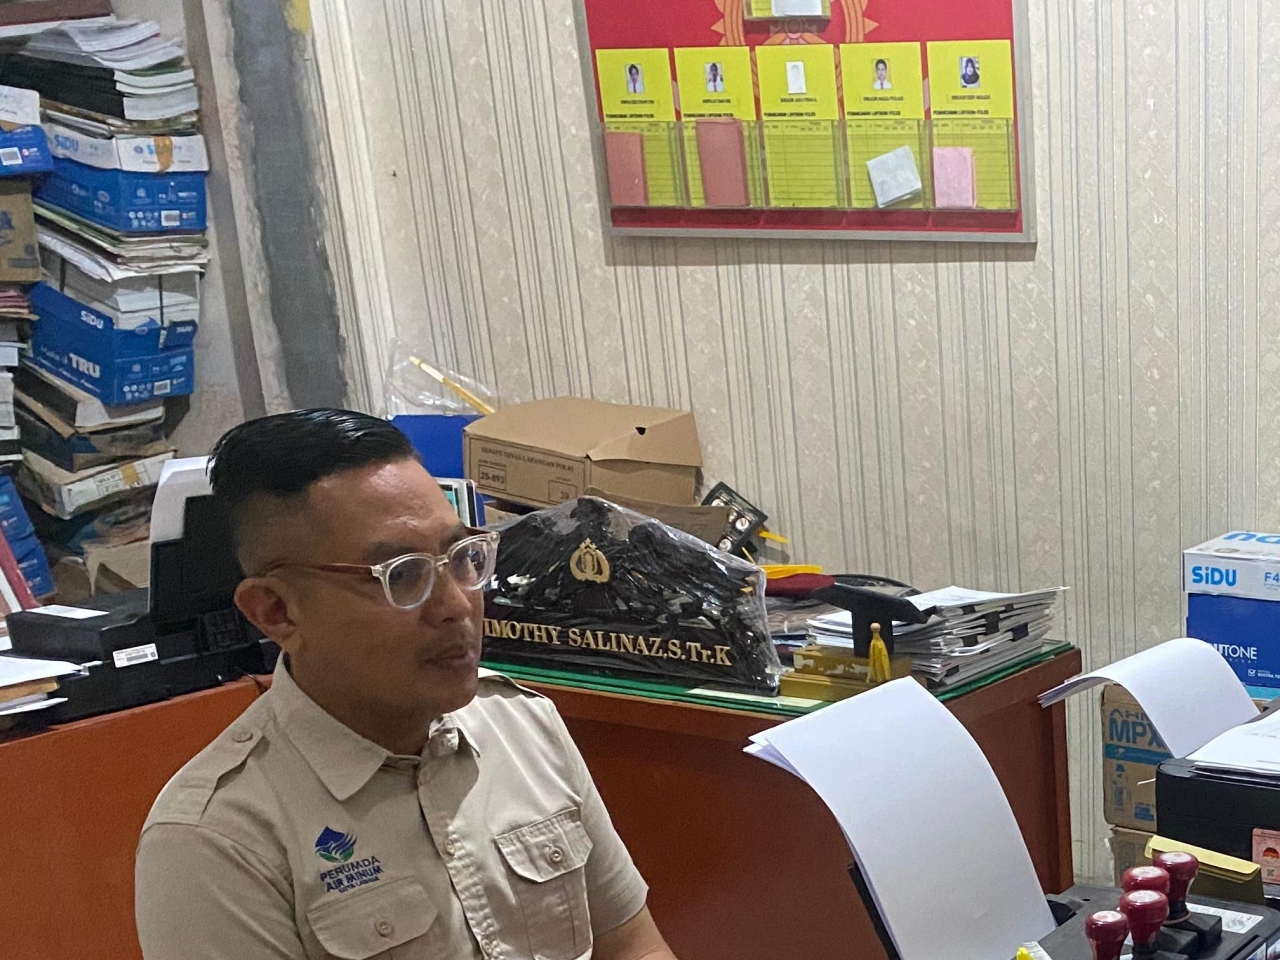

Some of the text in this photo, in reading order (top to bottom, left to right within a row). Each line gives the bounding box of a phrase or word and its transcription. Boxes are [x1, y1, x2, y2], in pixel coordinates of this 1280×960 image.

[80, 310, 104, 329] SiDU
[1191, 565, 1237, 587] SiDU
[1264, 571, 1280, 584] F4
[483, 618, 561, 645] IMOTHY
[320, 856, 381, 881] PERUMDA
[326, 865, 385, 892] AIR MINUM
